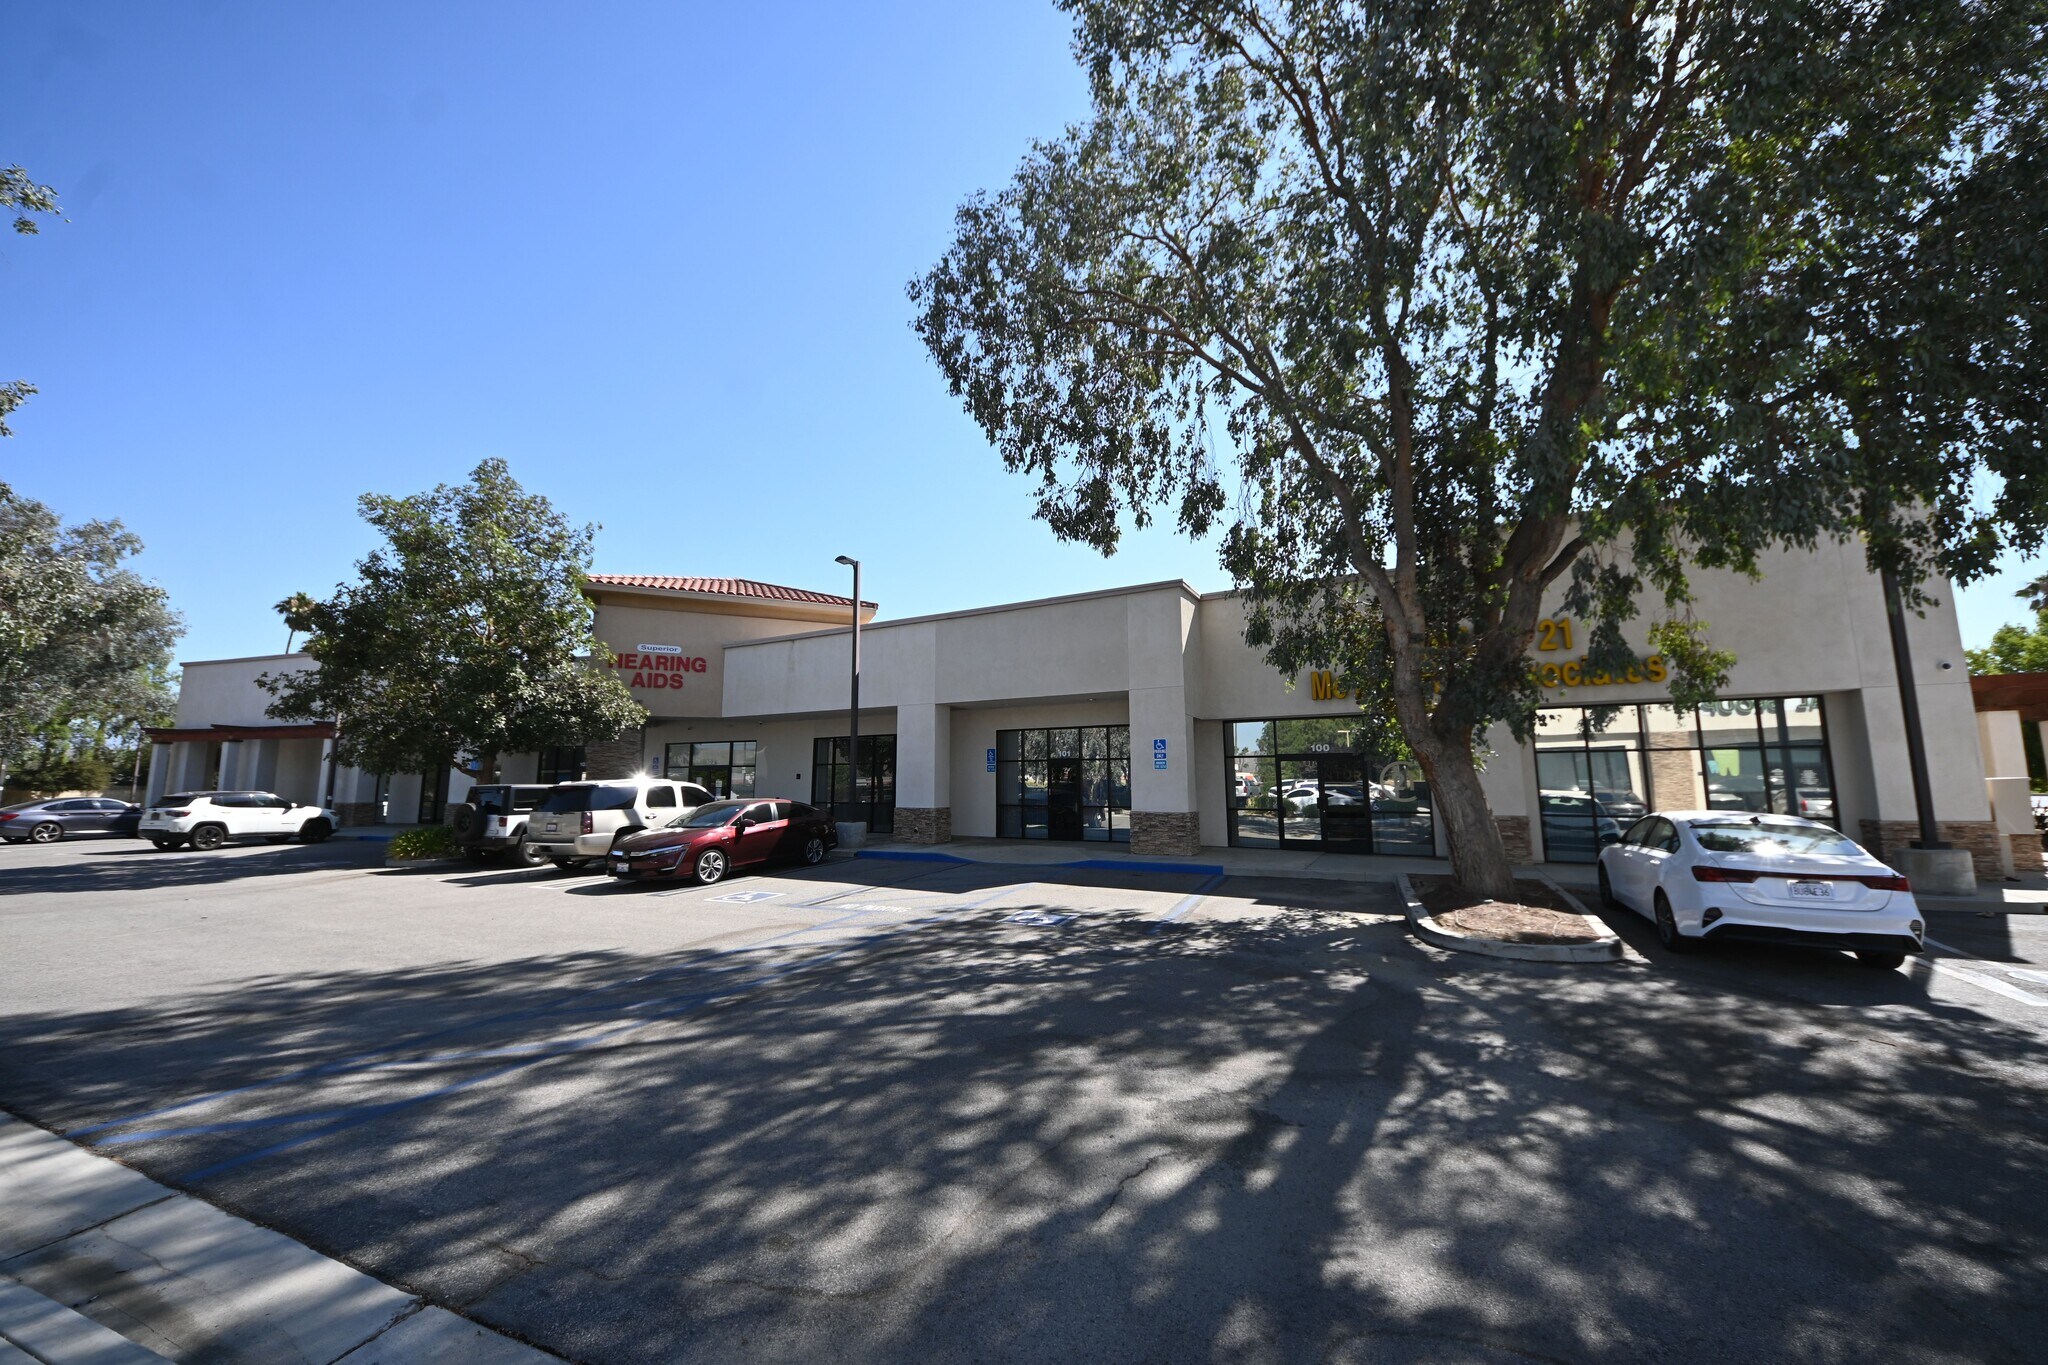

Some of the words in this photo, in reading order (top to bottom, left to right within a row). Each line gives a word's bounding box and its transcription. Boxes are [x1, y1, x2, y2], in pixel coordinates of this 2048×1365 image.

[1538, 617, 1573, 651] 21
[640, 644, 679, 653] Superior
[608, 653, 707, 673] HEARING
[630, 672, 684, 689] AIDS
[1310, 743, 1330, 752] 100
